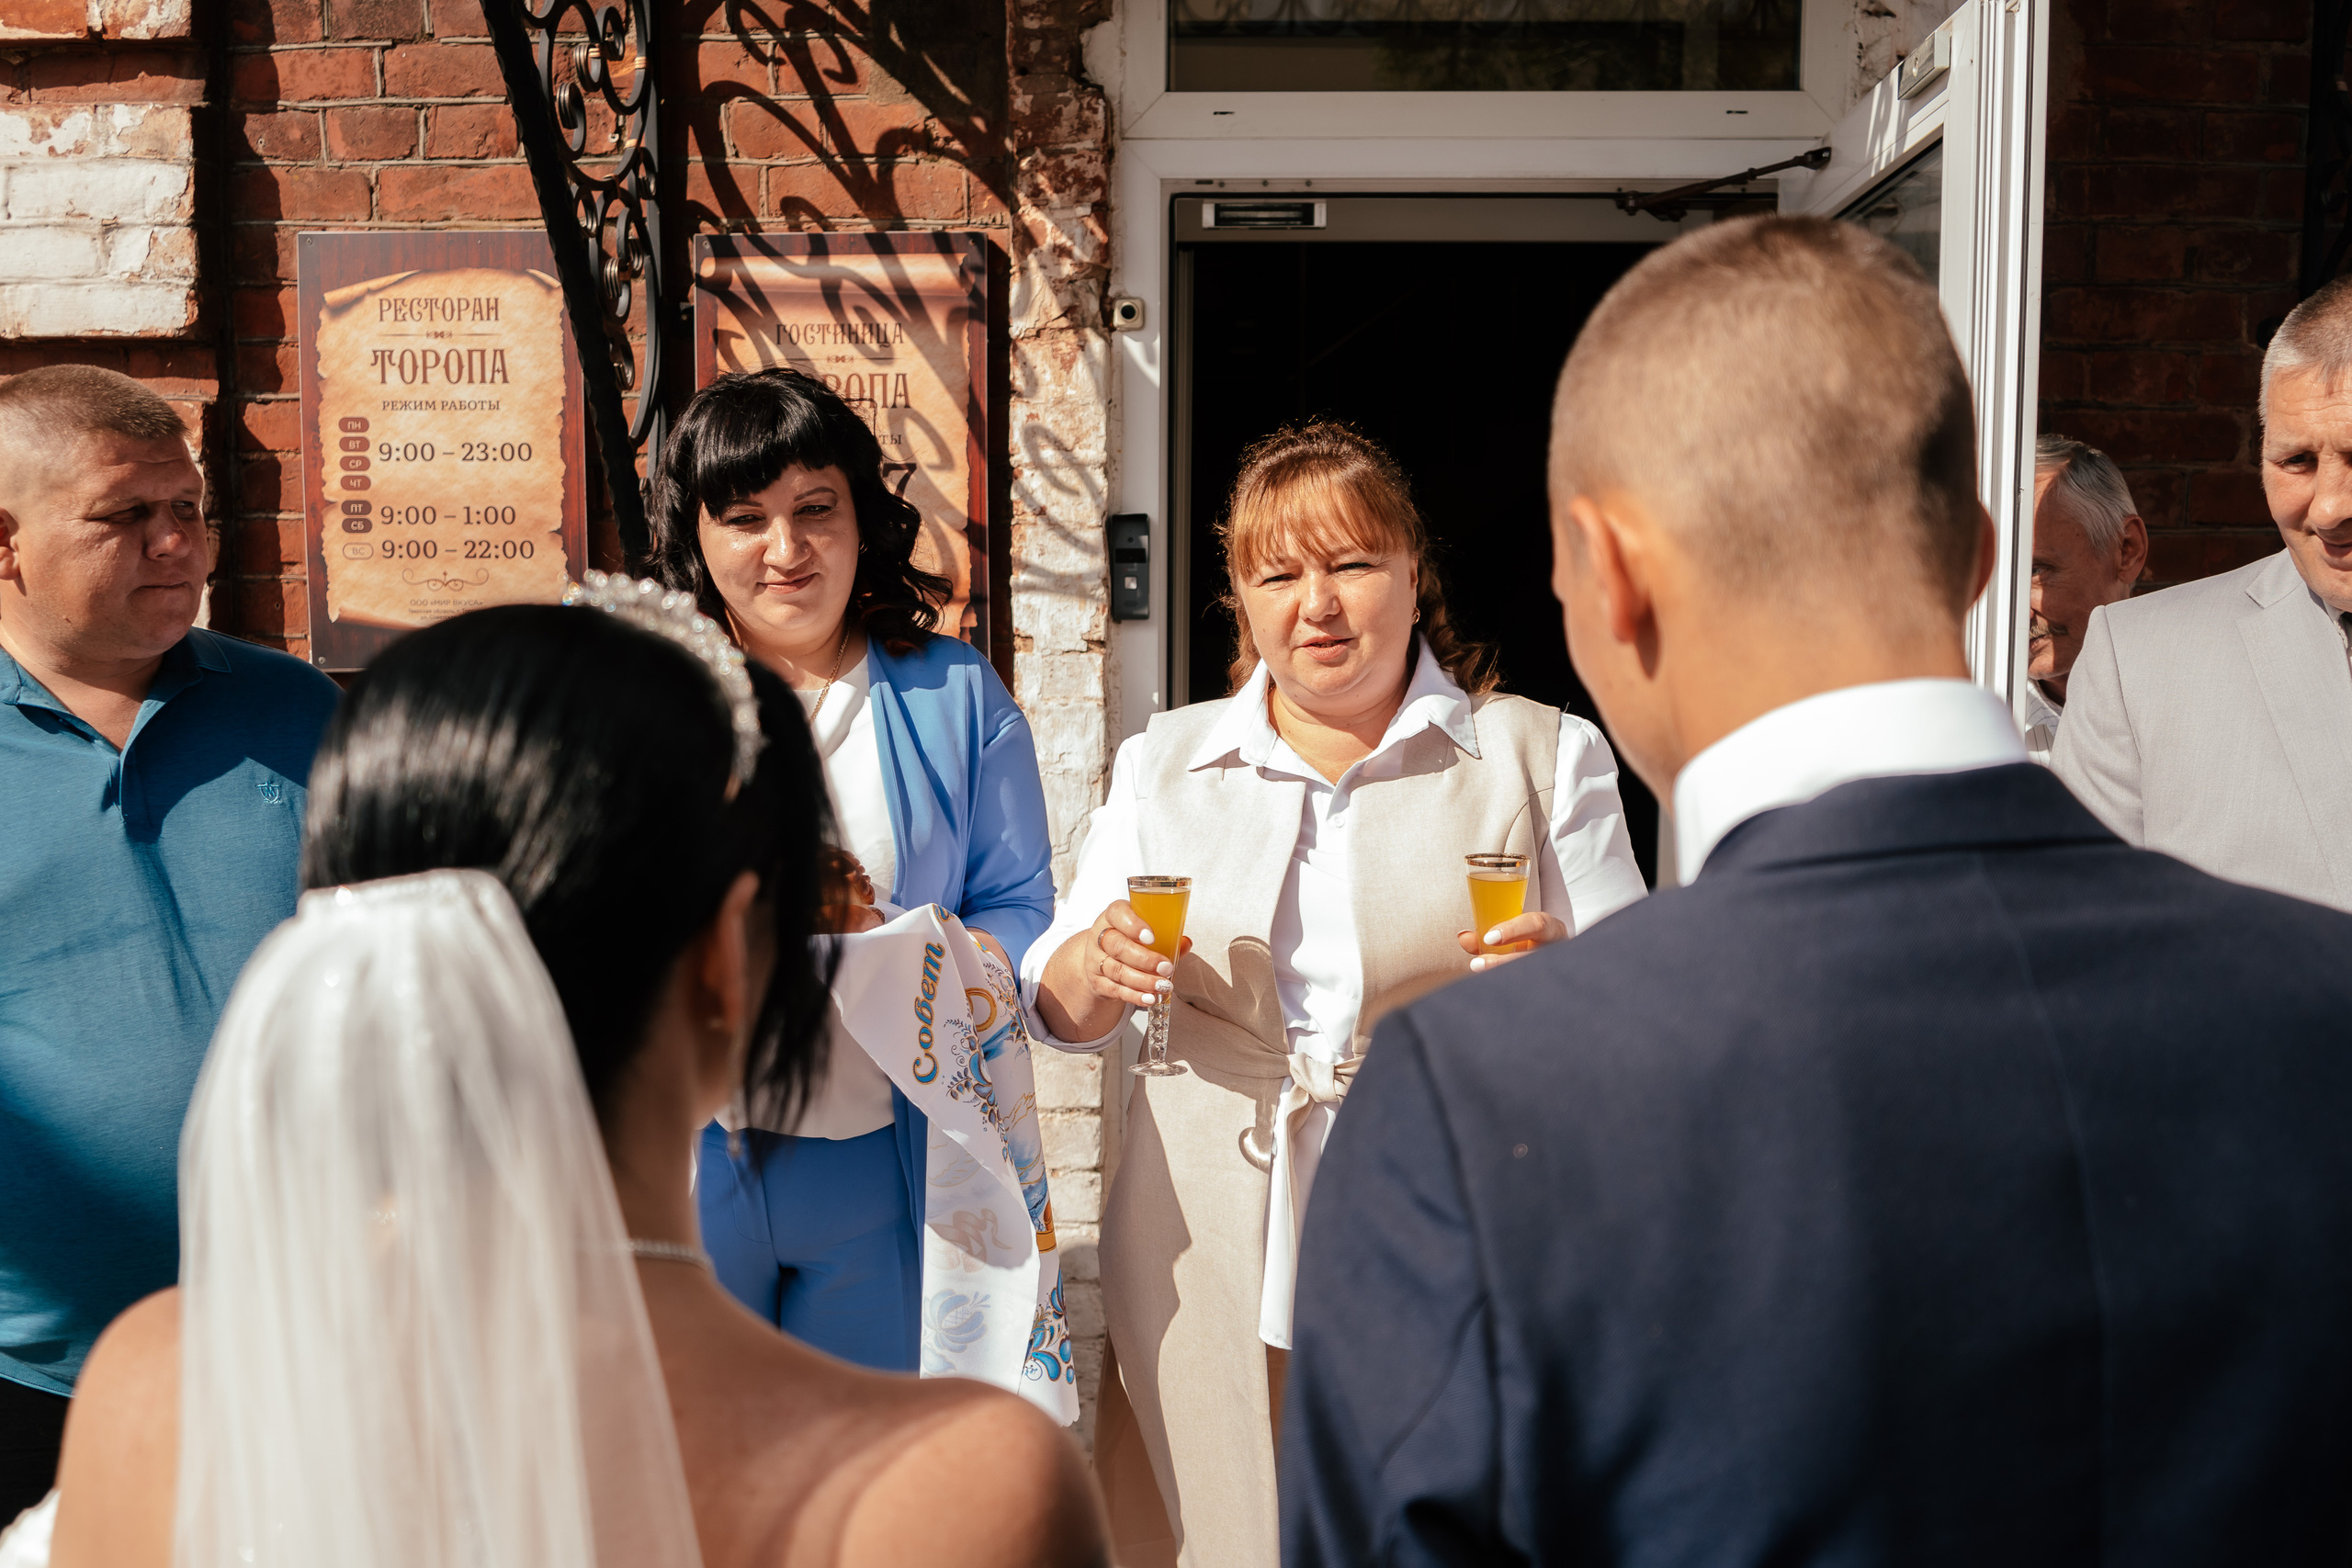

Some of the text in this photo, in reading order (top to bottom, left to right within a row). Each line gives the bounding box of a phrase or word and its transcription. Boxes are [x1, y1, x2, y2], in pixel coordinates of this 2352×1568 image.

[379, 297, 500, 322] РЕСТОРАН
[775, 322, 904, 348] ГОСТИНИЦА
[370, 348, 510, 385] ТОРОПА
[382, 400, 501, 412] РЕЖИМ РАБОТЫ
[347, 421, 362, 431] ПН
[348, 440, 361, 450] ВТ
[379, 442, 435, 462] 9:00
[461, 442, 533, 462] 23:00
[348, 459, 362, 469] СР
[349, 479, 362, 489] ЧТ
[350, 503, 363, 513] ПТ
[380, 505, 437, 525] 9:00
[463, 505, 516, 525] 1:00
[350, 521, 364, 531] СБ
[352, 547, 365, 556] ВС
[381, 539, 438, 559] 9:00
[464, 539, 535, 559] 22:00
[410, 598, 428, 606] ООО
[913, 942, 945, 1085] Совет
